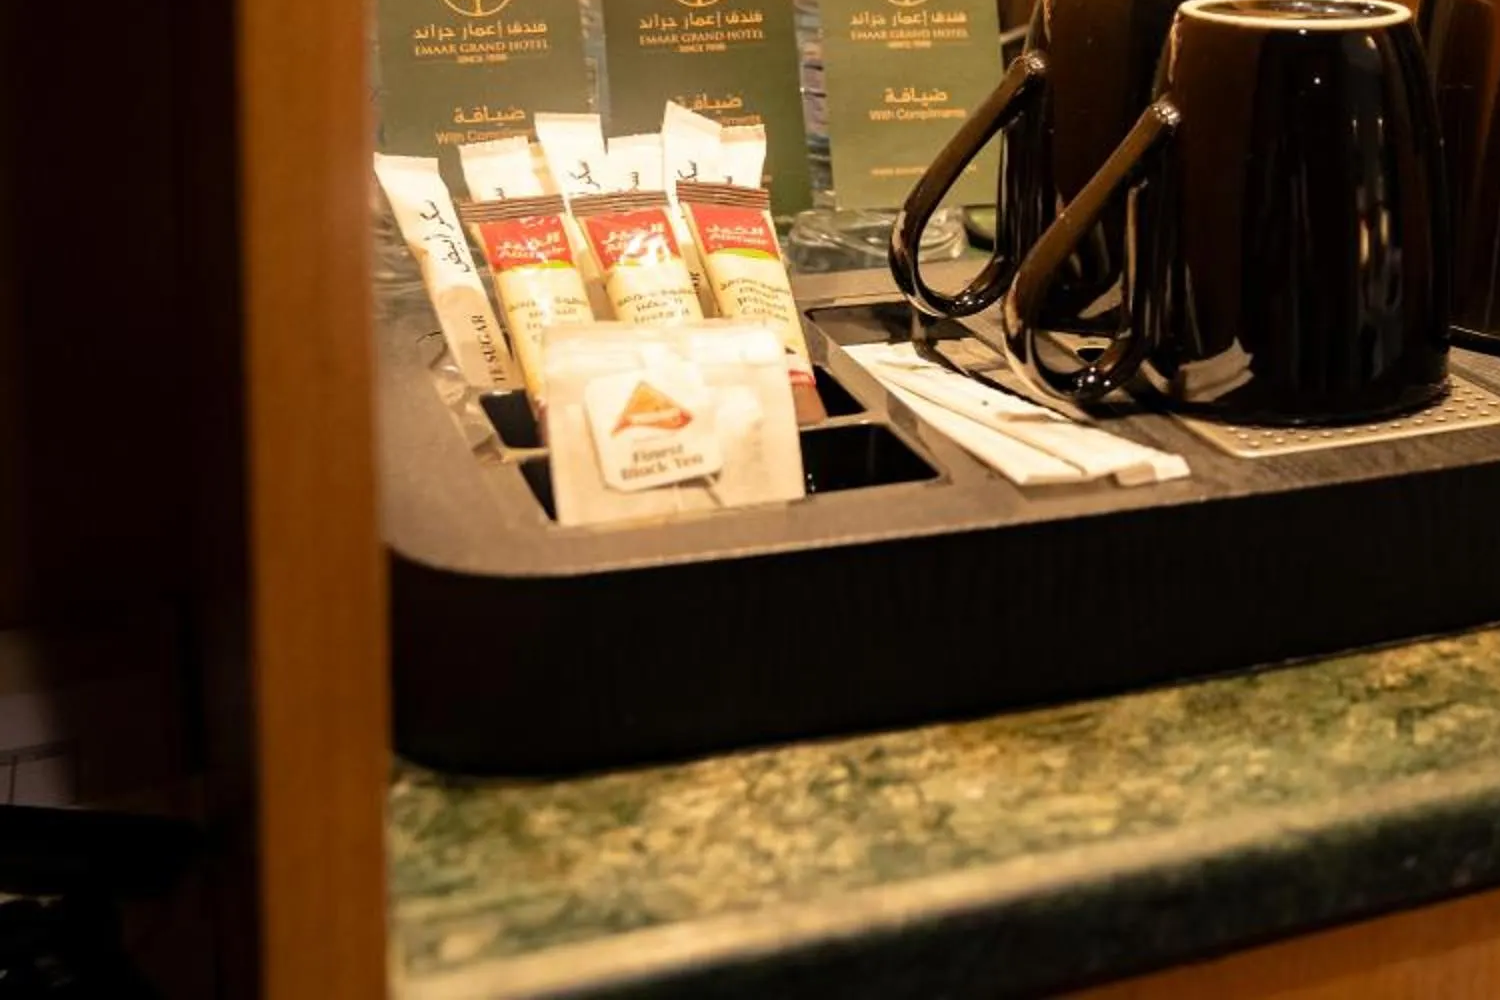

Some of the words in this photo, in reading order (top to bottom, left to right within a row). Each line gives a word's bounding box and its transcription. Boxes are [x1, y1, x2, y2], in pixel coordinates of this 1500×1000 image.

[680, 31, 726, 44] GRAND
[727, 28, 765, 41] HOTEL
[888, 28, 931, 40] GRAND
[931, 27, 970, 39] HOTEL
[415, 43, 457, 56] EMAAR
[459, 40, 506, 54] GRAND
[508, 38, 549, 51] HOTEL
[883, 86, 949, 107] ضيافة
[452, 103, 526, 126] ضيافة
[470, 314, 496, 363] SUGAR
[619, 459, 670, 482] Black
[673, 451, 705, 470] Tea
